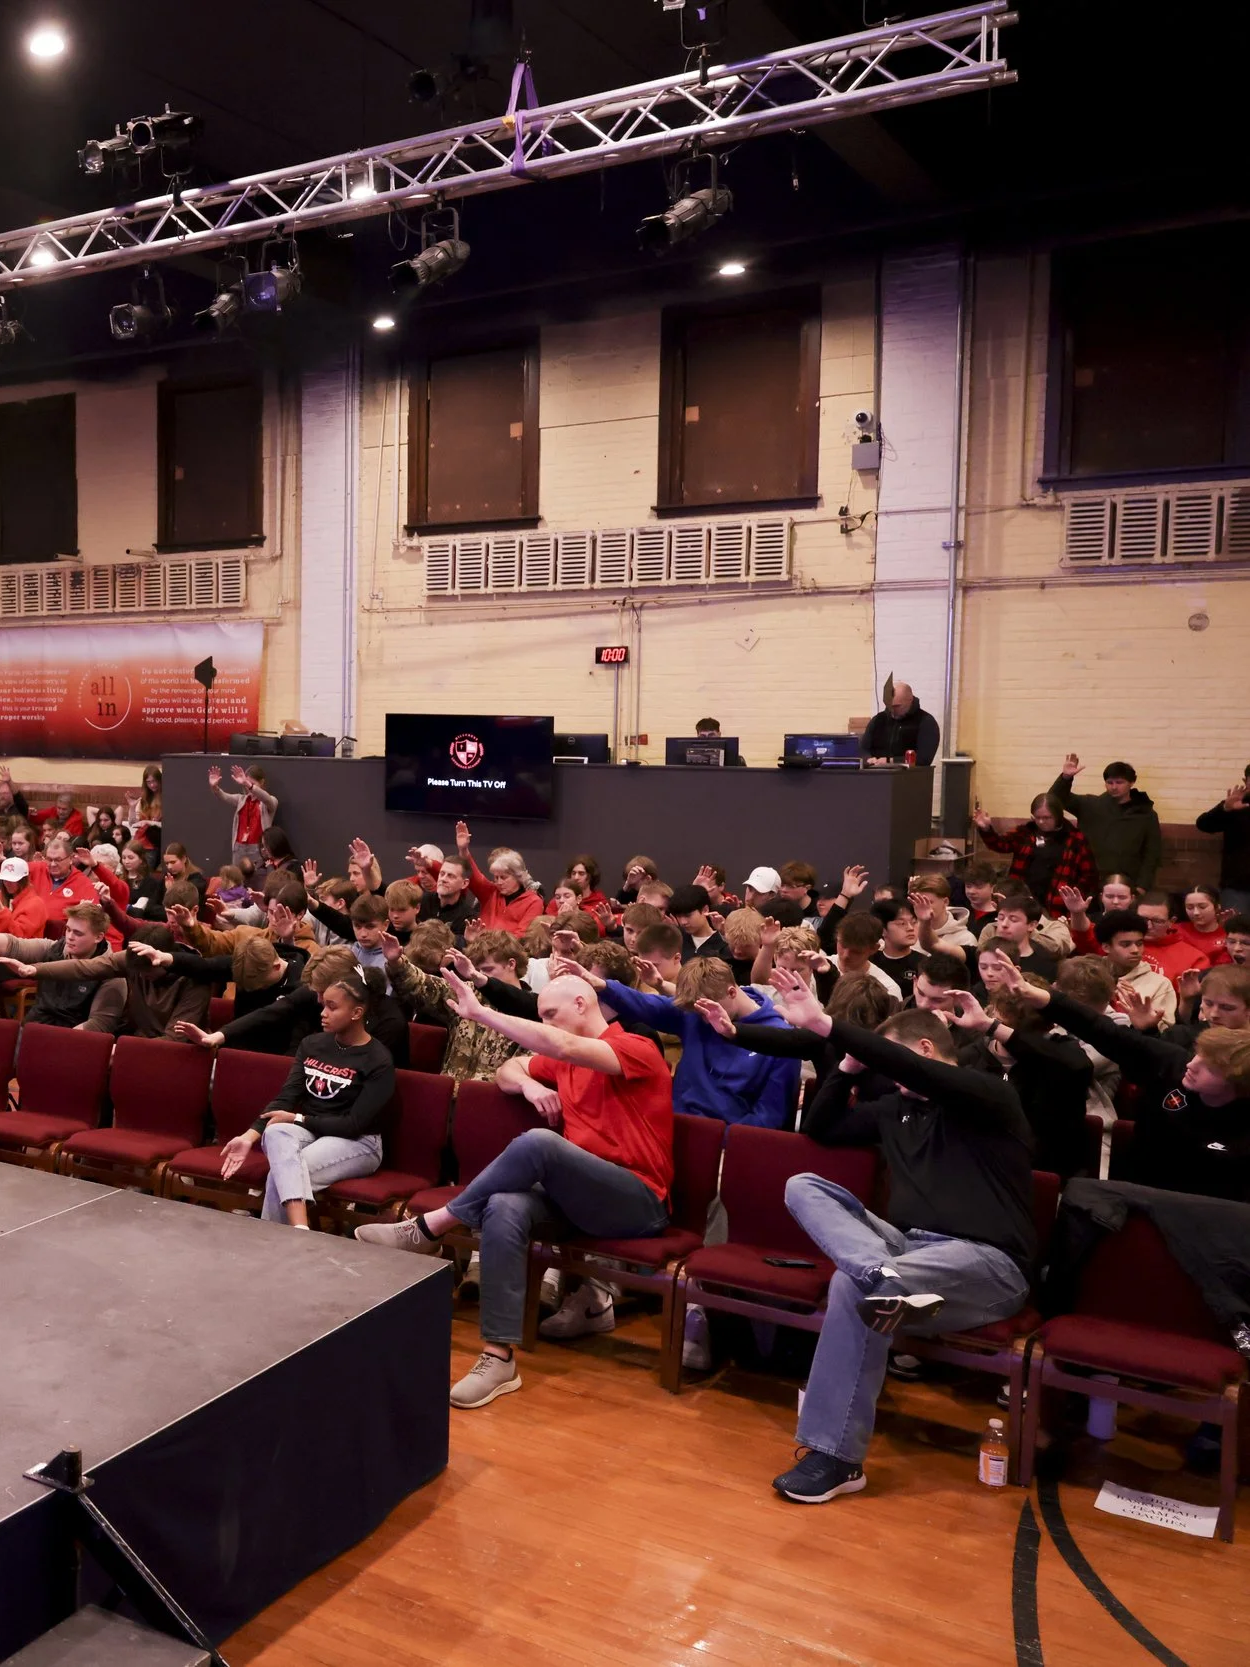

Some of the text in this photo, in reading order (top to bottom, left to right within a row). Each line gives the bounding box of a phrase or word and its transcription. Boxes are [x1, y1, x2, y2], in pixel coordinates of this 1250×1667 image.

[601, 648, 625, 661] 10:00
[91, 676, 116, 696] all
[98, 698, 117, 716] in
[303, 1057, 357, 1079] HILLCREST
